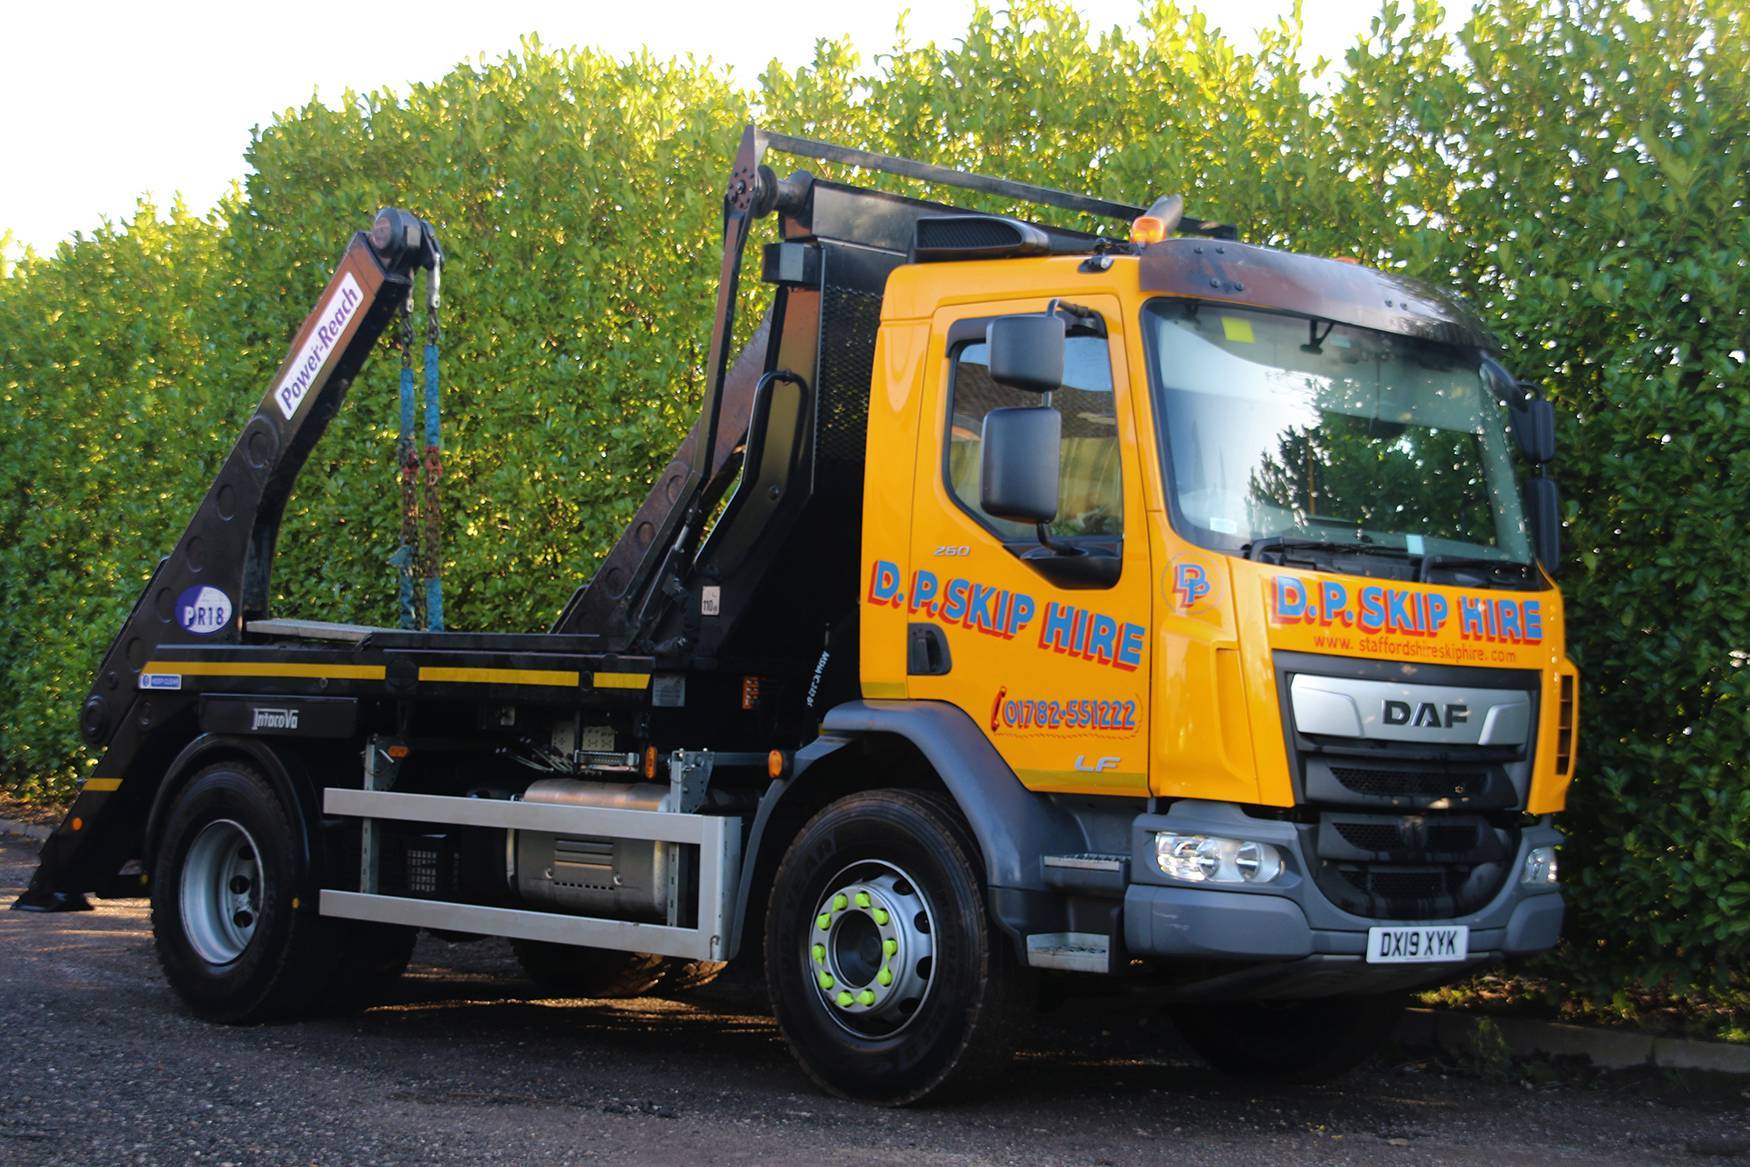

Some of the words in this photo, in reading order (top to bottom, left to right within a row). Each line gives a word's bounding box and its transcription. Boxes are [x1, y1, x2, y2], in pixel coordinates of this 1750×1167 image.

[280, 287, 358, 412] Power-Reach
[184, 605, 224, 626] PR18
[1459, 595, 1544, 645] HIRE
[1038, 602, 1146, 672] HIRE
[1381, 699, 1468, 728] DAF
[1074, 755, 1121, 773] LF
[1379, 931, 1421, 957] DX19
[1423, 930, 1458, 956] XYK
